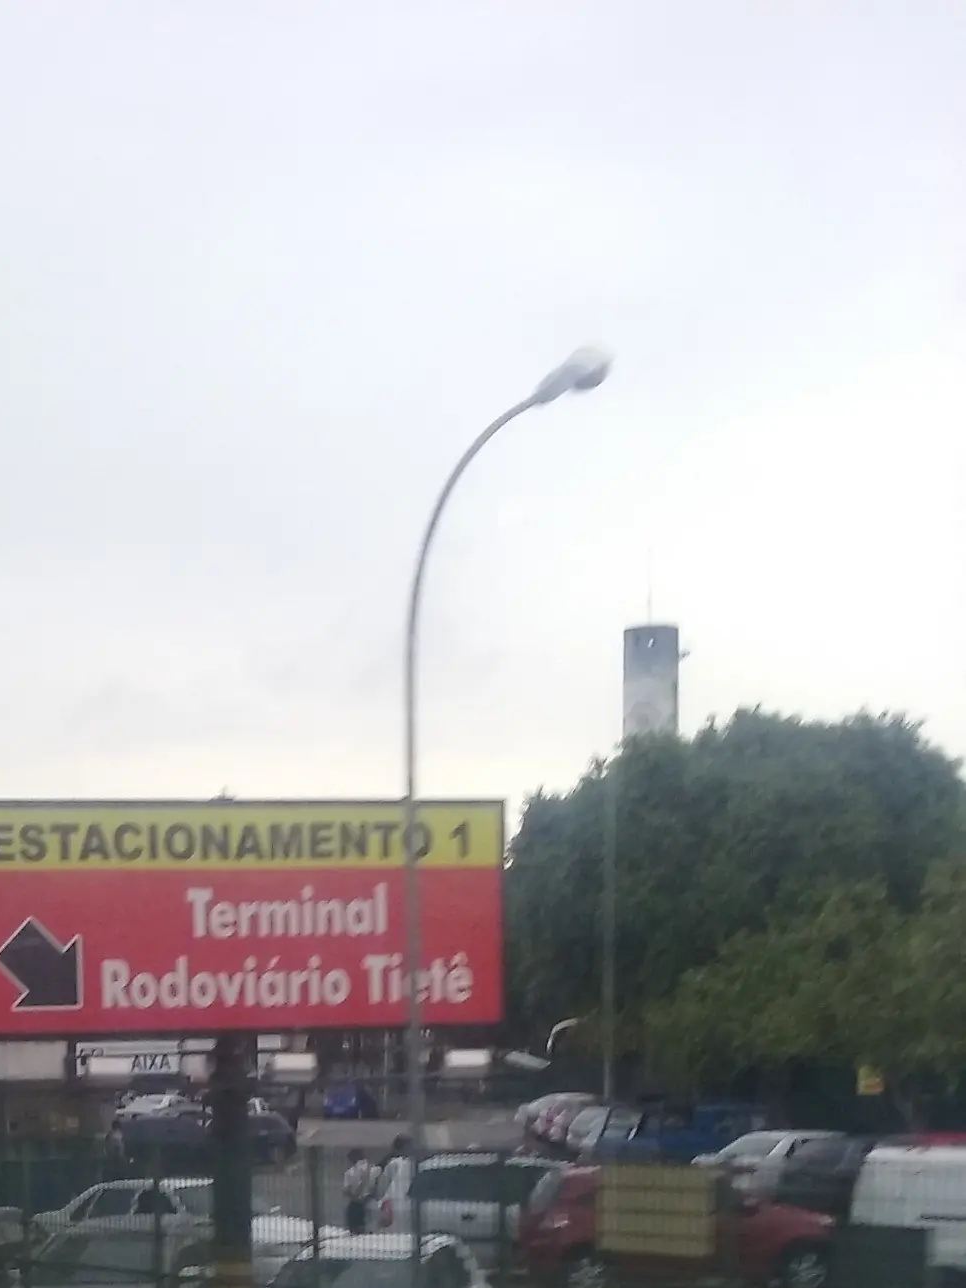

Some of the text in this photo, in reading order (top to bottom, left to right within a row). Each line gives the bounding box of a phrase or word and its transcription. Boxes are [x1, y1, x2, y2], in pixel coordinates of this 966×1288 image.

[448, 819, 471, 859] 1
[187, 882, 389, 938] Terminal
[101, 953, 351, 1010] Rodoviário
[131, 1054, 172, 1072] AIXA
